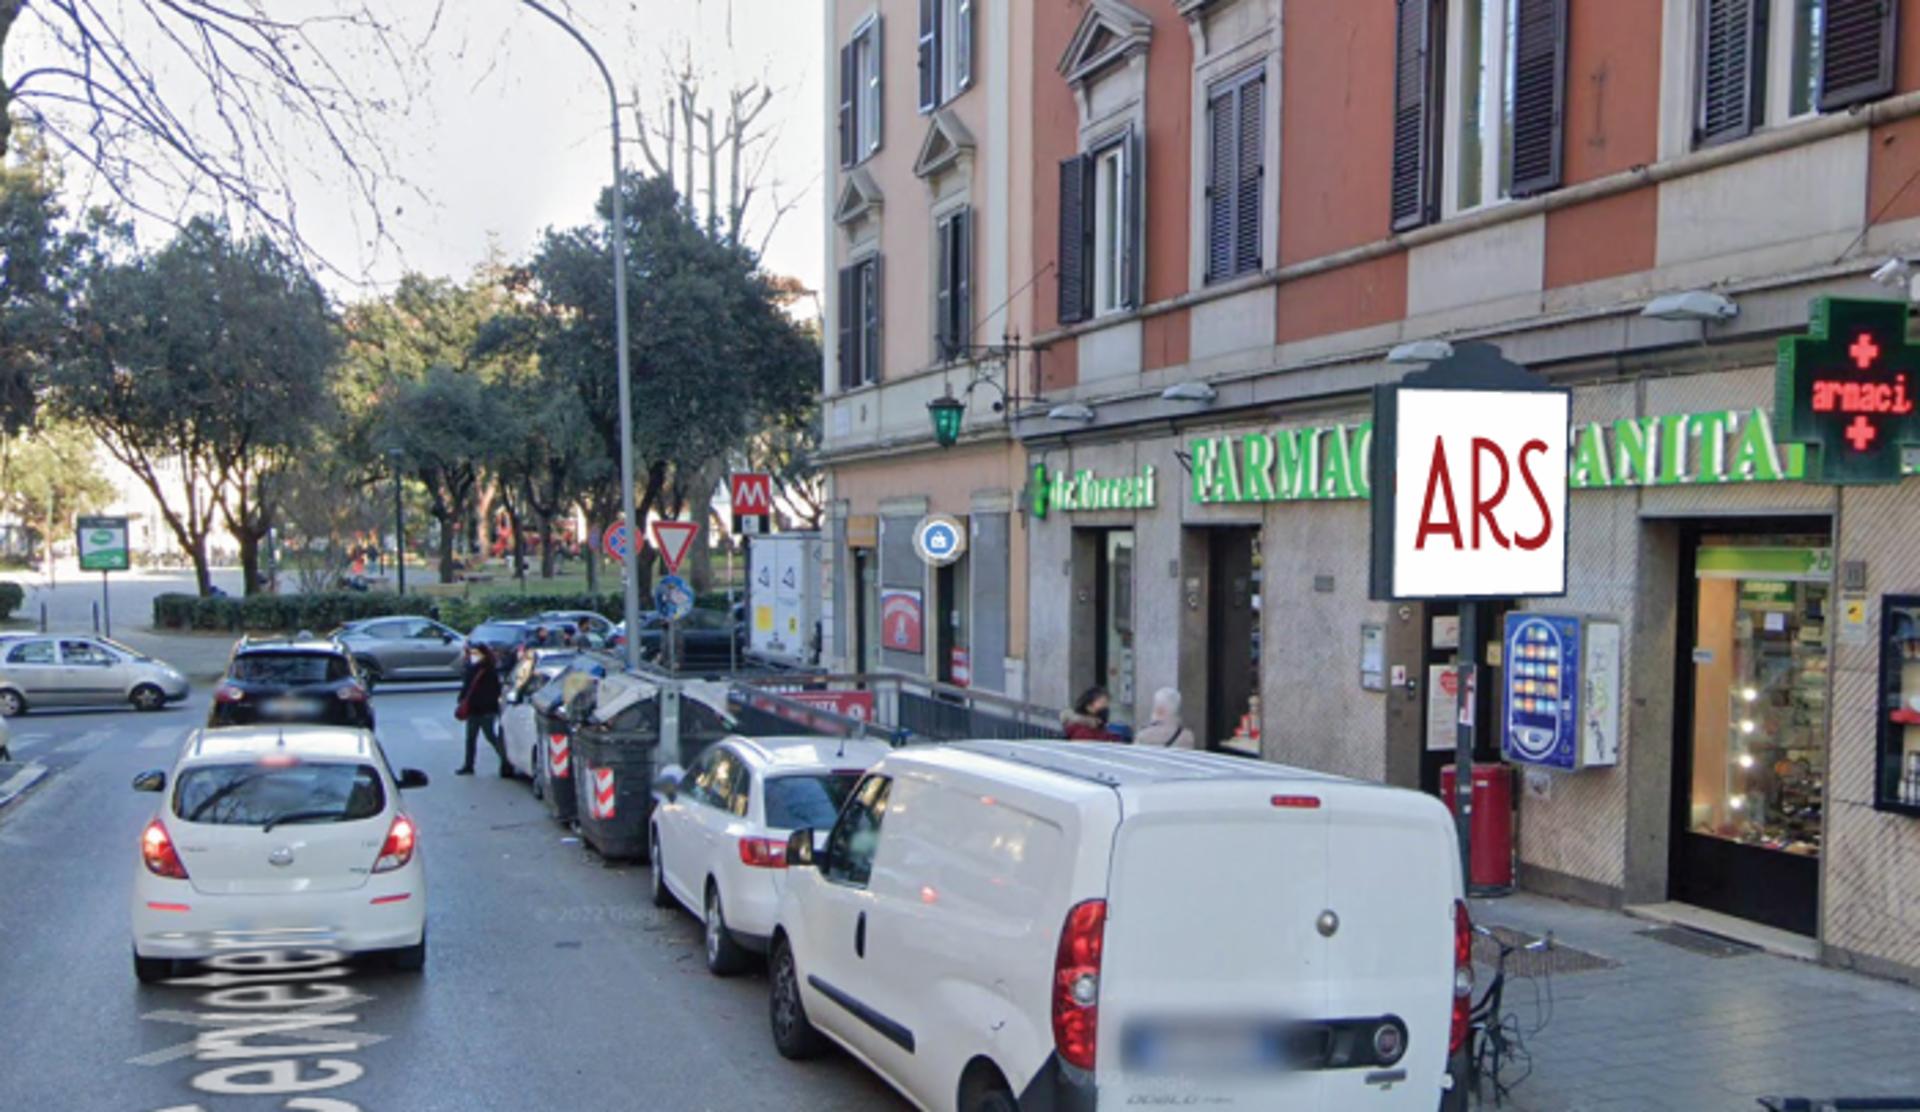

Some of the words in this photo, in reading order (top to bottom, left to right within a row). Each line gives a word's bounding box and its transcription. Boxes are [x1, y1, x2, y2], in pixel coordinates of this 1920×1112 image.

[1570, 407, 1804, 487] ANITA
[735, 480, 767, 507] M
[1415, 435, 1553, 551] ARS
